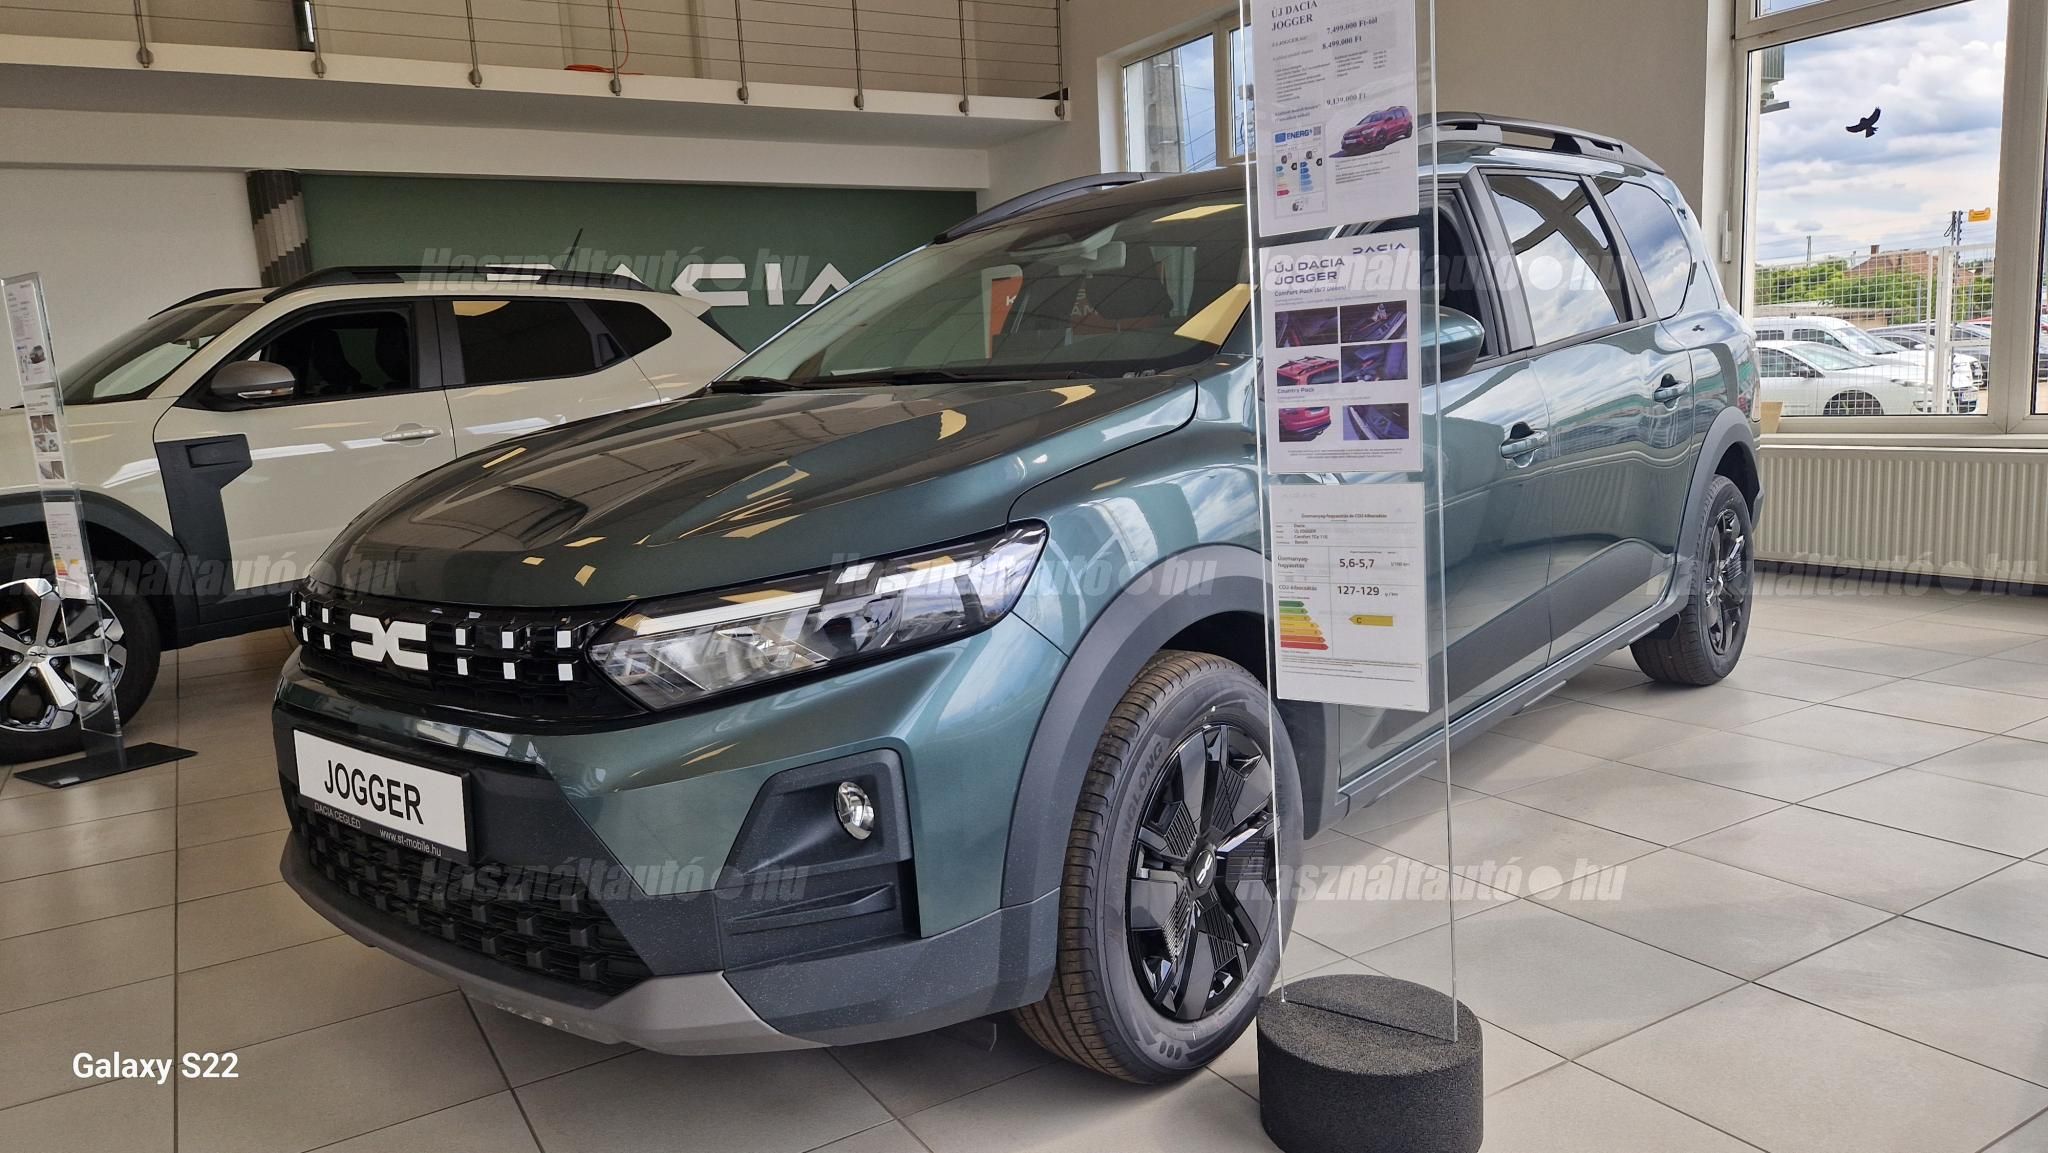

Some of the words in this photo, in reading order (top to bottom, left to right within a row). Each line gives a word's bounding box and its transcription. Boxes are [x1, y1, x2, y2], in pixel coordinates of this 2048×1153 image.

[1285, 0, 1318, 15] DACIA
[1271, 13, 1313, 31] JOGGER
[1353, 242, 1407, 255] DACIA
[1297, 257, 1346, 271] DACIA
[1274, 271, 1338, 285] JOGGER
[1339, 558, 1375, 569] 5,6-5,7
[1337, 585, 1380, 596] 127-129
[324, 759, 424, 825] JOGGER
[314, 802, 335, 818] DACIA
[379, 828, 442, 857] www.st-mobile.hu
